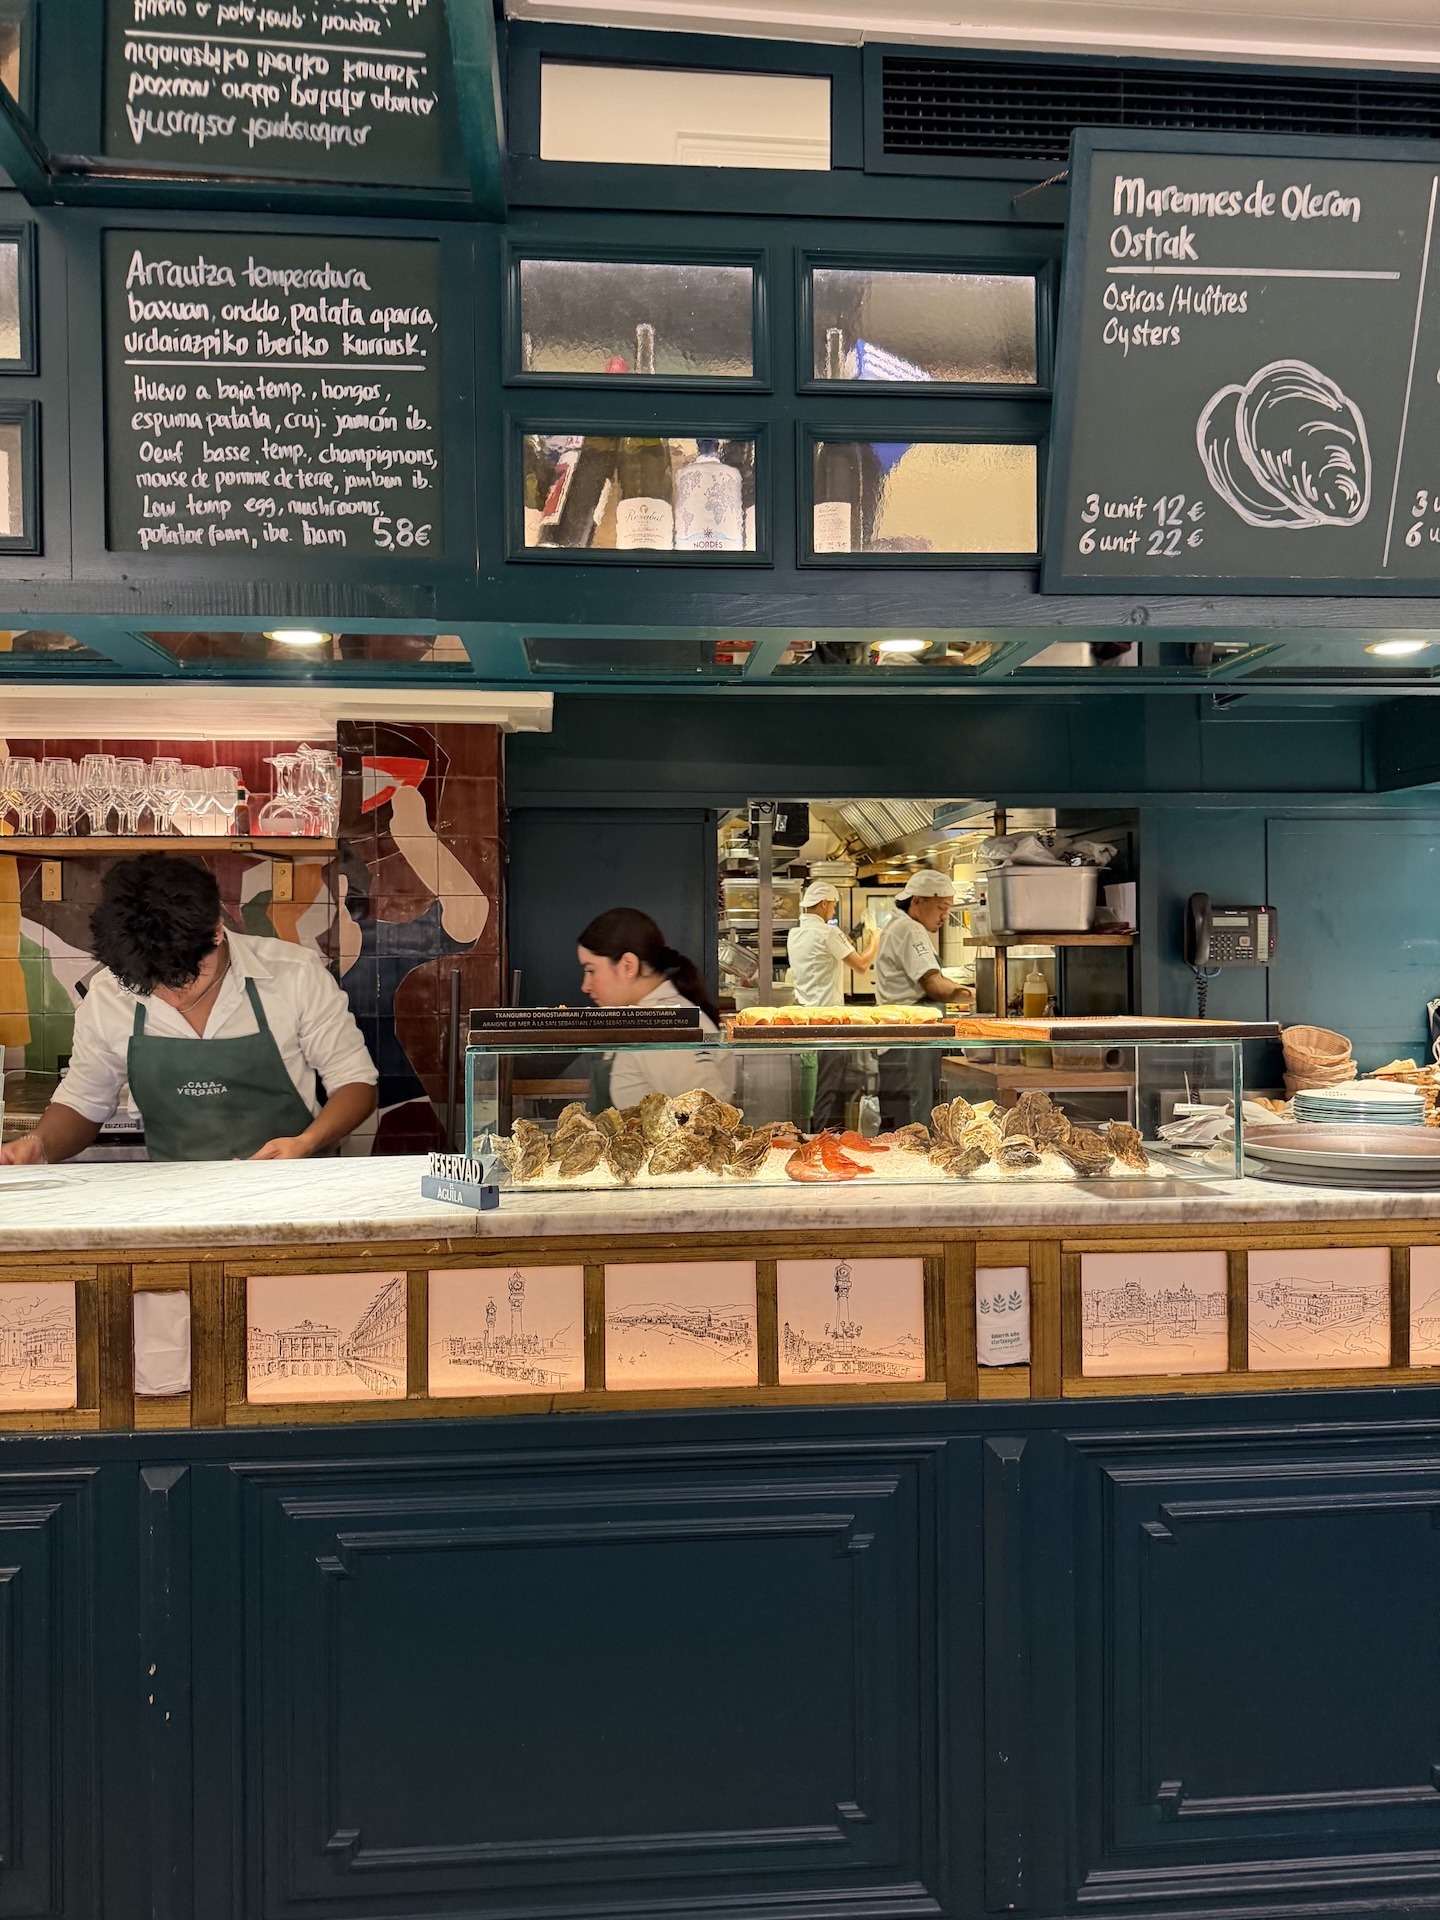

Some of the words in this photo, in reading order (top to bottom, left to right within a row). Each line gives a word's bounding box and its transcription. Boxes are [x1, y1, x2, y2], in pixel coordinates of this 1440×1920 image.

[1113, 175, 1242, 218] Marennes
[1244, 180, 1275, 218] de
[1281, 183, 1361, 223] Oleron
[1109, 225, 1199, 261] Ostrak
[126, 250, 236, 289] Arrautza
[241, 256, 371, 296] temperatura
[1102, 282, 1165, 313] Ostras
[221, 299, 287, 326] onddo,
[290, 297, 366, 335] patata
[124, 328, 249, 360] urdaiazpiko
[257, 328, 329, 358] iberiko
[1102, 316, 1181, 358] Oysters
[134, 375, 187, 402] Huevo
[196, 384, 211, 400] a
[217, 378, 255, 406] baja
[321, 379, 391, 405] hongos,
[131, 411, 203, 437] espuma
[206, 405, 280, 437] patata,
[284, 409, 326, 438] cruj.
[333, 407, 397, 438] jamón
[406, 405, 432, 431] ib.
[139, 441, 184, 463] Oeuf
[318, 443, 438, 470] champignons,
[136, 470, 188, 488] mouse
[192, 468, 210, 488] de
[216, 470, 270, 493] pomme
[274, 467, 294, 488] de
[412, 469, 433, 489] ib.
[143, 494, 176, 517] Low
[186, 493, 231, 520] temp
[244, 497, 284, 518] egg,
[1081, 493, 1100, 523] 3
[1103, 495, 1147, 520] unit
[1411, 489, 1428, 517] 3
[302, 520, 346, 547] ham
[373, 516, 432, 552] 5,8€
[1078, 528, 1097, 554] 6
[1100, 529, 1141, 554] unit
[1405, 521, 1424, 547] 6
[176, 1085, 228, 1097] VERGARA
[187, 1081, 216, 1089] CASA
[437, 1185, 463, 1204] ÁGUILA
